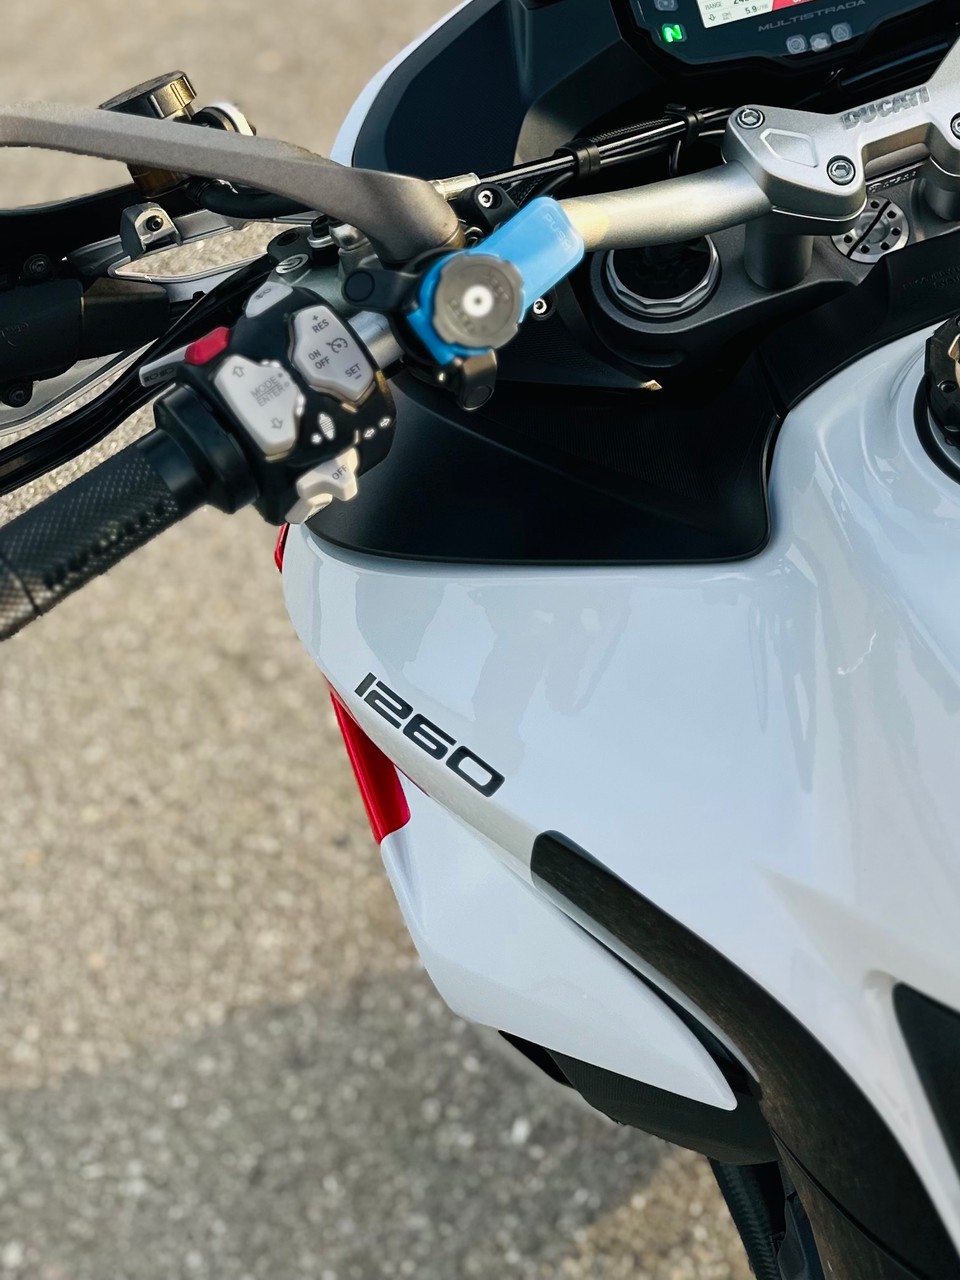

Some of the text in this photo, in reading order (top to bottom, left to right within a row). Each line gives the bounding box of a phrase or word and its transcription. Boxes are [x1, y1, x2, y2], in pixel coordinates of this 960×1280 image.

[704, 1, 723, 11] RANGE
[744, 5, 758, 15] 5.9
[757, 0, 867, 33] MULTISTRADA
[840, 86, 931, 130] DUCATI
[543, 212, 574, 250] PUSH
[312, 318, 330, 334] RES
[307, 348, 322, 362] ON
[314, 355, 332, 370] OFF
[344, 362, 361, 378] SET
[250, 375, 279, 398] MODE
[256, 386, 284, 408] ENTER
[331, 464, 349, 481] OFF
[353, 671, 506, 798] 1260
